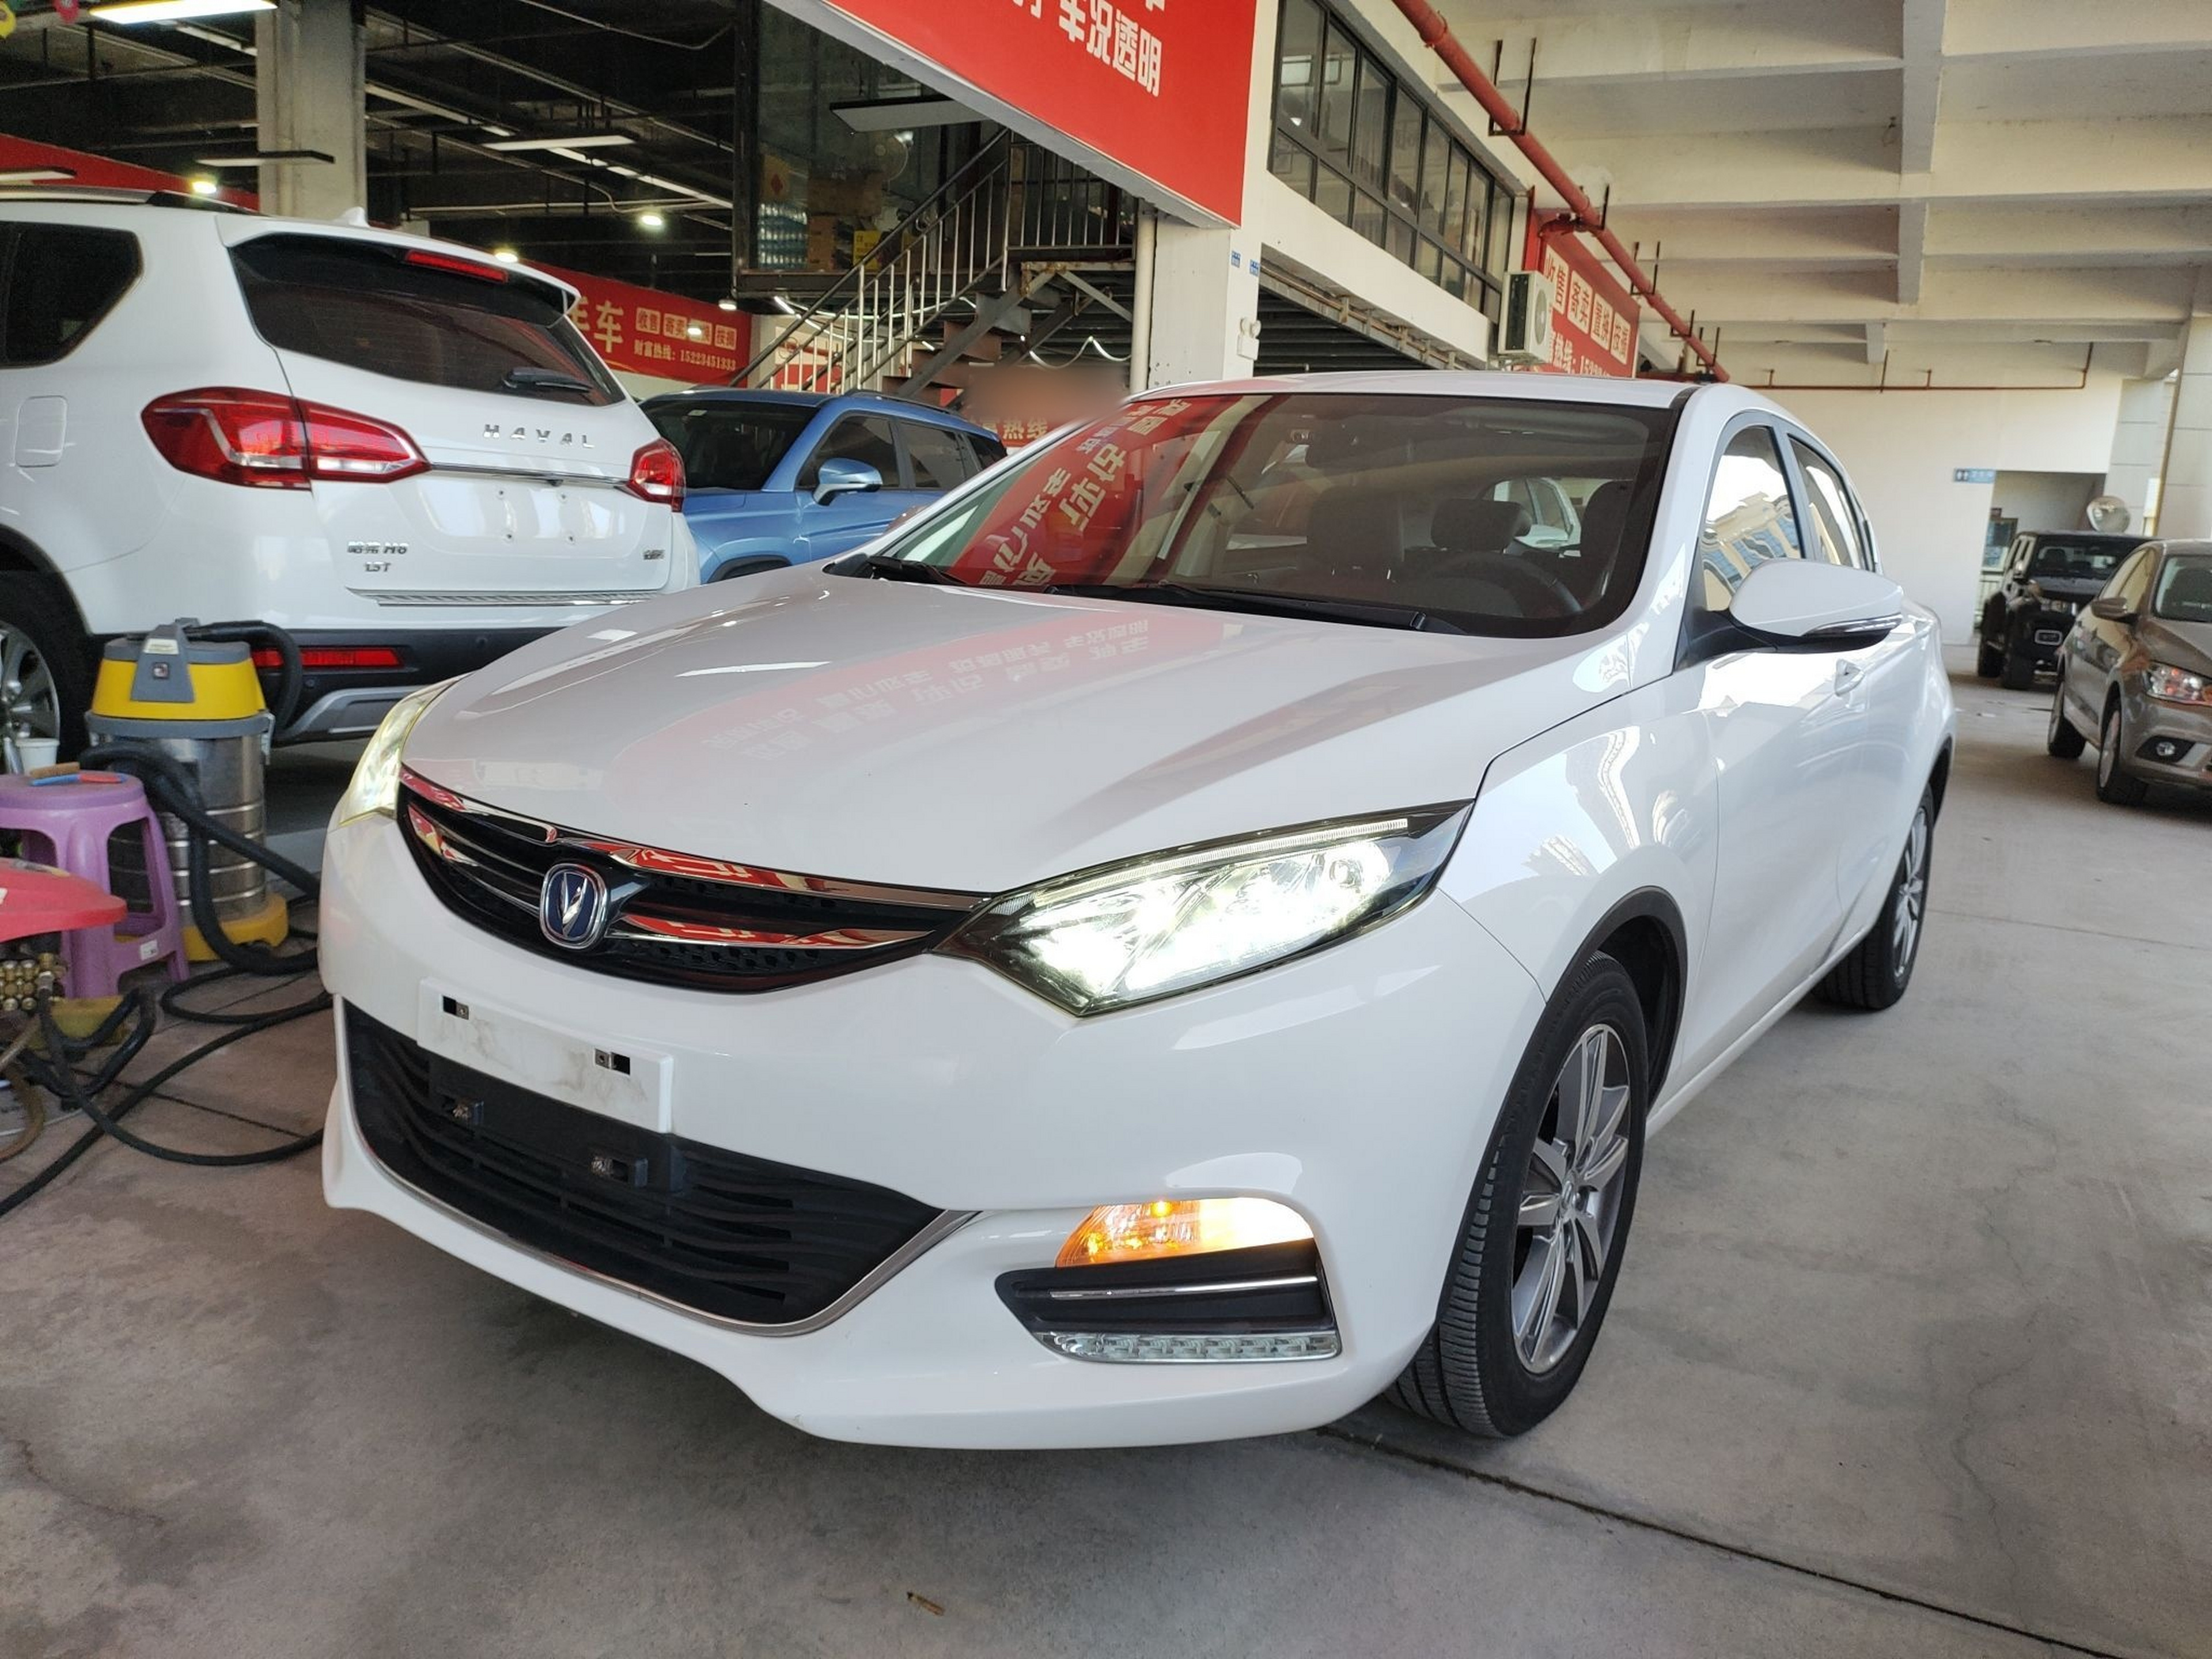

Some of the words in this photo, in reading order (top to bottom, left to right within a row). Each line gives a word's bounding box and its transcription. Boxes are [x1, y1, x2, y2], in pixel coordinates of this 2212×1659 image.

[1059, 0, 1162, 97] 车况透明
[483, 424, 595, 449] HAVAL
